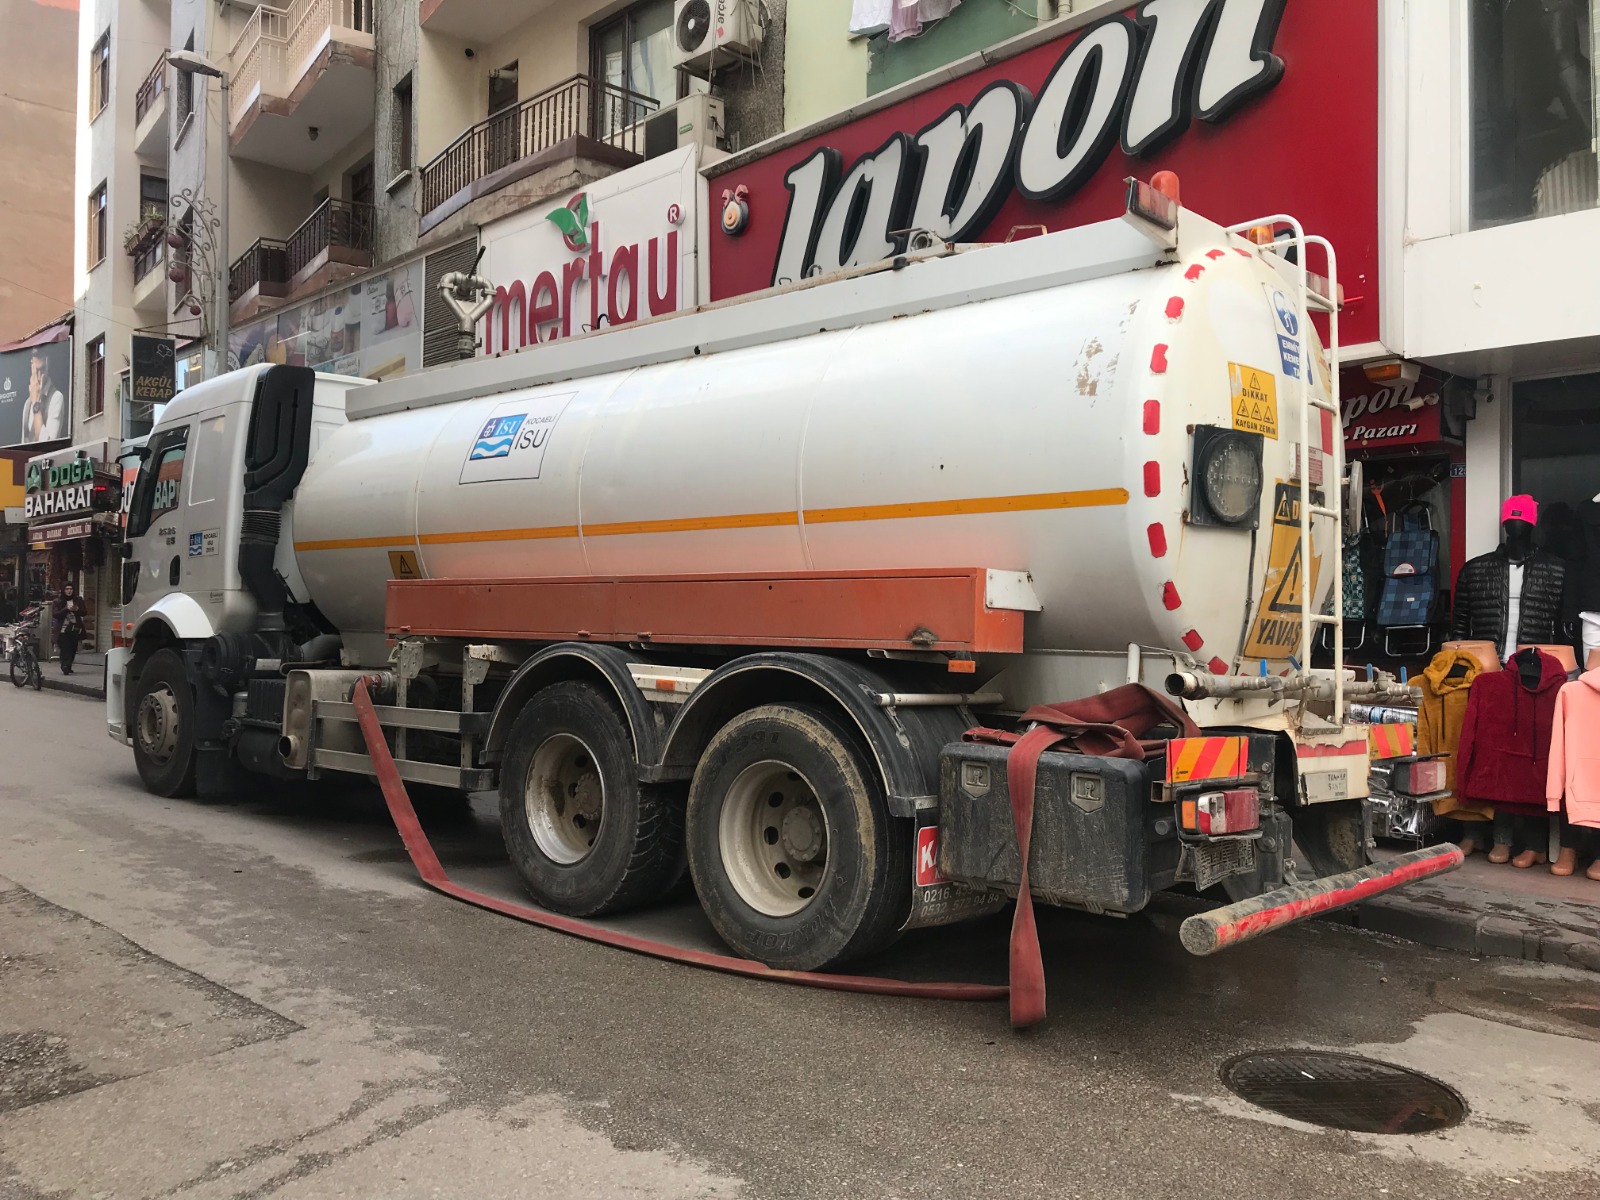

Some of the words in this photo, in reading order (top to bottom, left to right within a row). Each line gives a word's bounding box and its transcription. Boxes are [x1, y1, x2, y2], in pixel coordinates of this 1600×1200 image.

[136, 375, 172, 388] AKGÜL
[135, 386, 173, 398] KEBAP
[1242, 387, 1268, 403] DİKKAT
[1342, 383, 1416, 429] pon
[1235, 418, 1258, 431] KAYGAN
[1259, 424, 1276, 435] ZEMİN
[1353, 423, 1417, 440] Pazarı
[49, 449, 95, 488] DOĞA
[25, 483, 93, 518] BAHARAT
